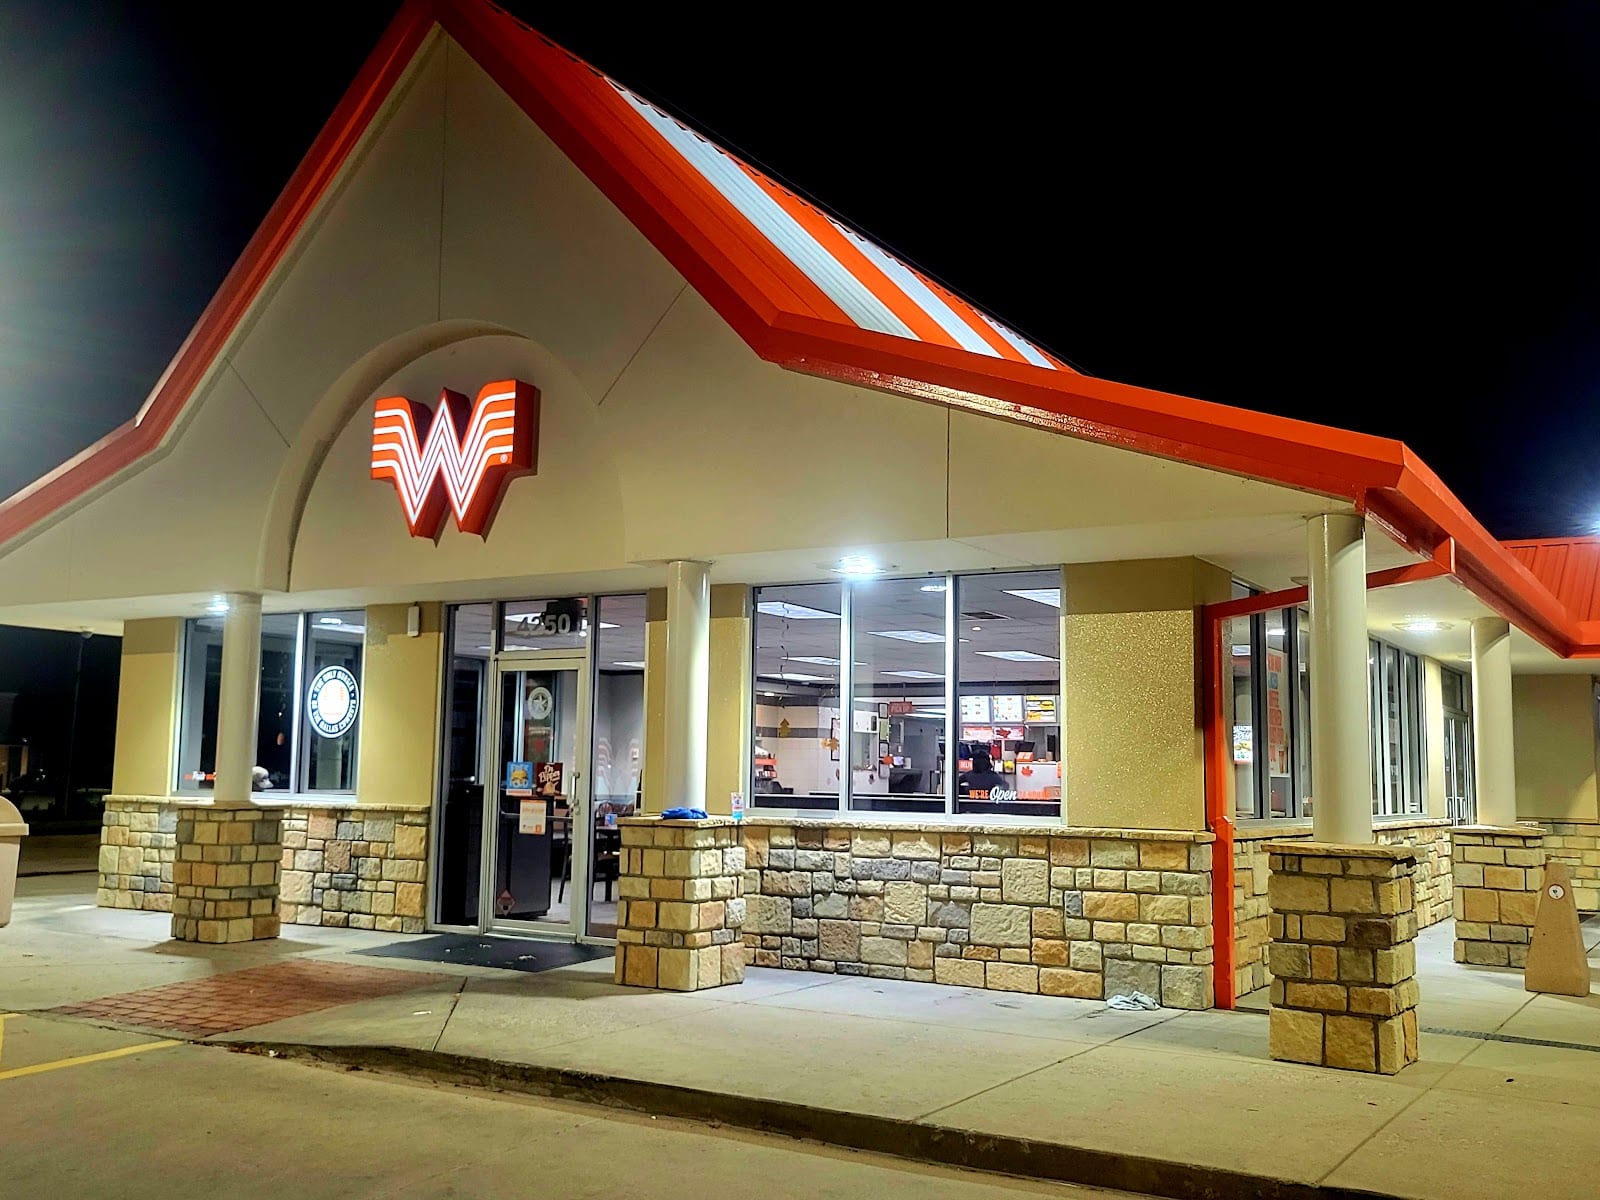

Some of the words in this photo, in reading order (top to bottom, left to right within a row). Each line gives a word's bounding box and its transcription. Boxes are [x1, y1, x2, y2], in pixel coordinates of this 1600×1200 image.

[370, 378, 530, 540] W
[516, 613, 571, 637] 4250
[969, 789, 989, 800] WE'RE
[989, 785, 1017, 804] Open
